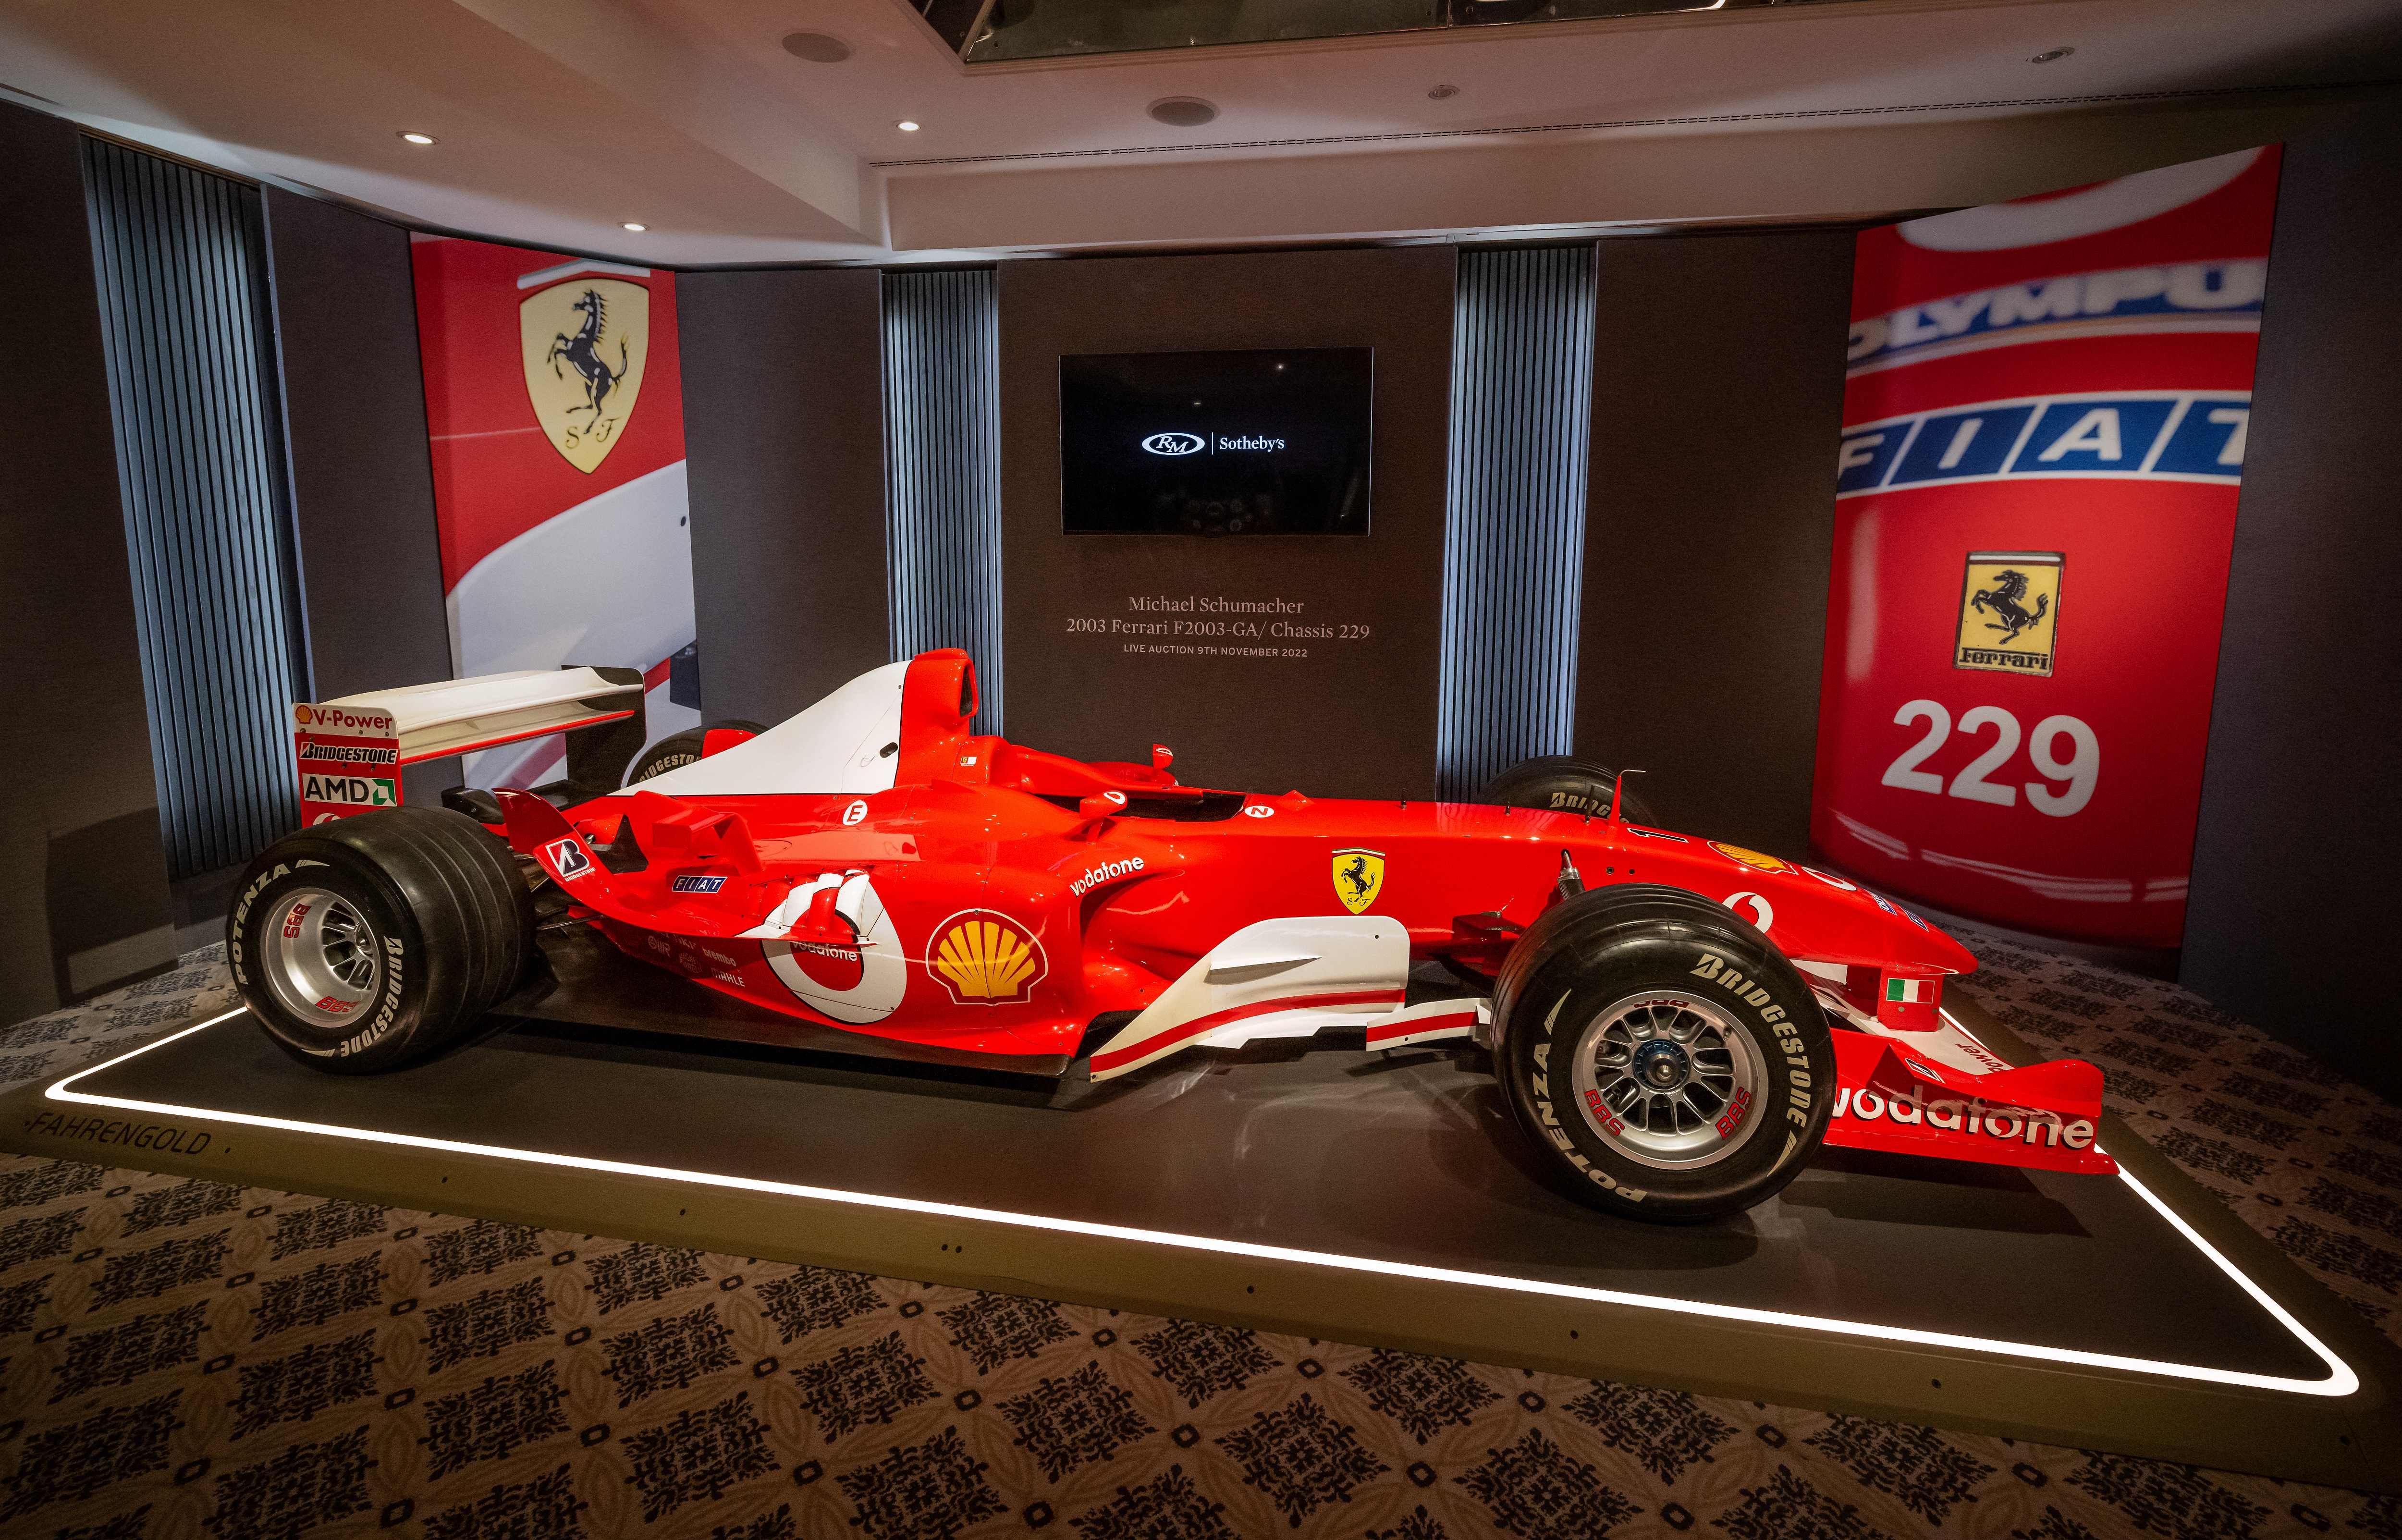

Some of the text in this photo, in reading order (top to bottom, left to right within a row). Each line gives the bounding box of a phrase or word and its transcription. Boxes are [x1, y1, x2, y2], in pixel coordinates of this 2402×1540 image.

[1156, 436, 1285, 452] RM Sotheby's
[1129, 596, 1304, 613] Michael Schumacher
[1066, 618, 1370, 640] 2003 Ferrari F2003-GA/ Chassis 229
[1124, 644, 1308, 657] LIVE AUCTION 9TH NOVEMBER 2022
[1959, 647, 2049, 670] Ferrari
[313, 709, 392, 729] V-Power
[300, 742, 399, 764] BRIDGESTONE
[1881, 699, 2100, 817] 229
[305, 776, 369, 802] AMD
[847, 805, 863, 822] E
[1250, 807, 1268, 816] N
[564, 867, 596, 882] BRIDGESTONE
[676, 878, 722, 890] FIAT
[1070, 857, 1145, 897] vodafone
[233, 863, 291, 985] POTENZA
[283, 903, 312, 938] BBS
[315, 996, 360, 1013] BBS
[340, 935, 404, 1057] BRIDGESTONE
[1690, 953, 1811, 1128] BRIDGESTONE
[1532, 1043, 1648, 1202] POTENZA
[1585, 1089, 1625, 1136] BBS
[1716, 1087, 1752, 1140] BBS
[27, 1112, 211, 1154] FAHRENGOLD
